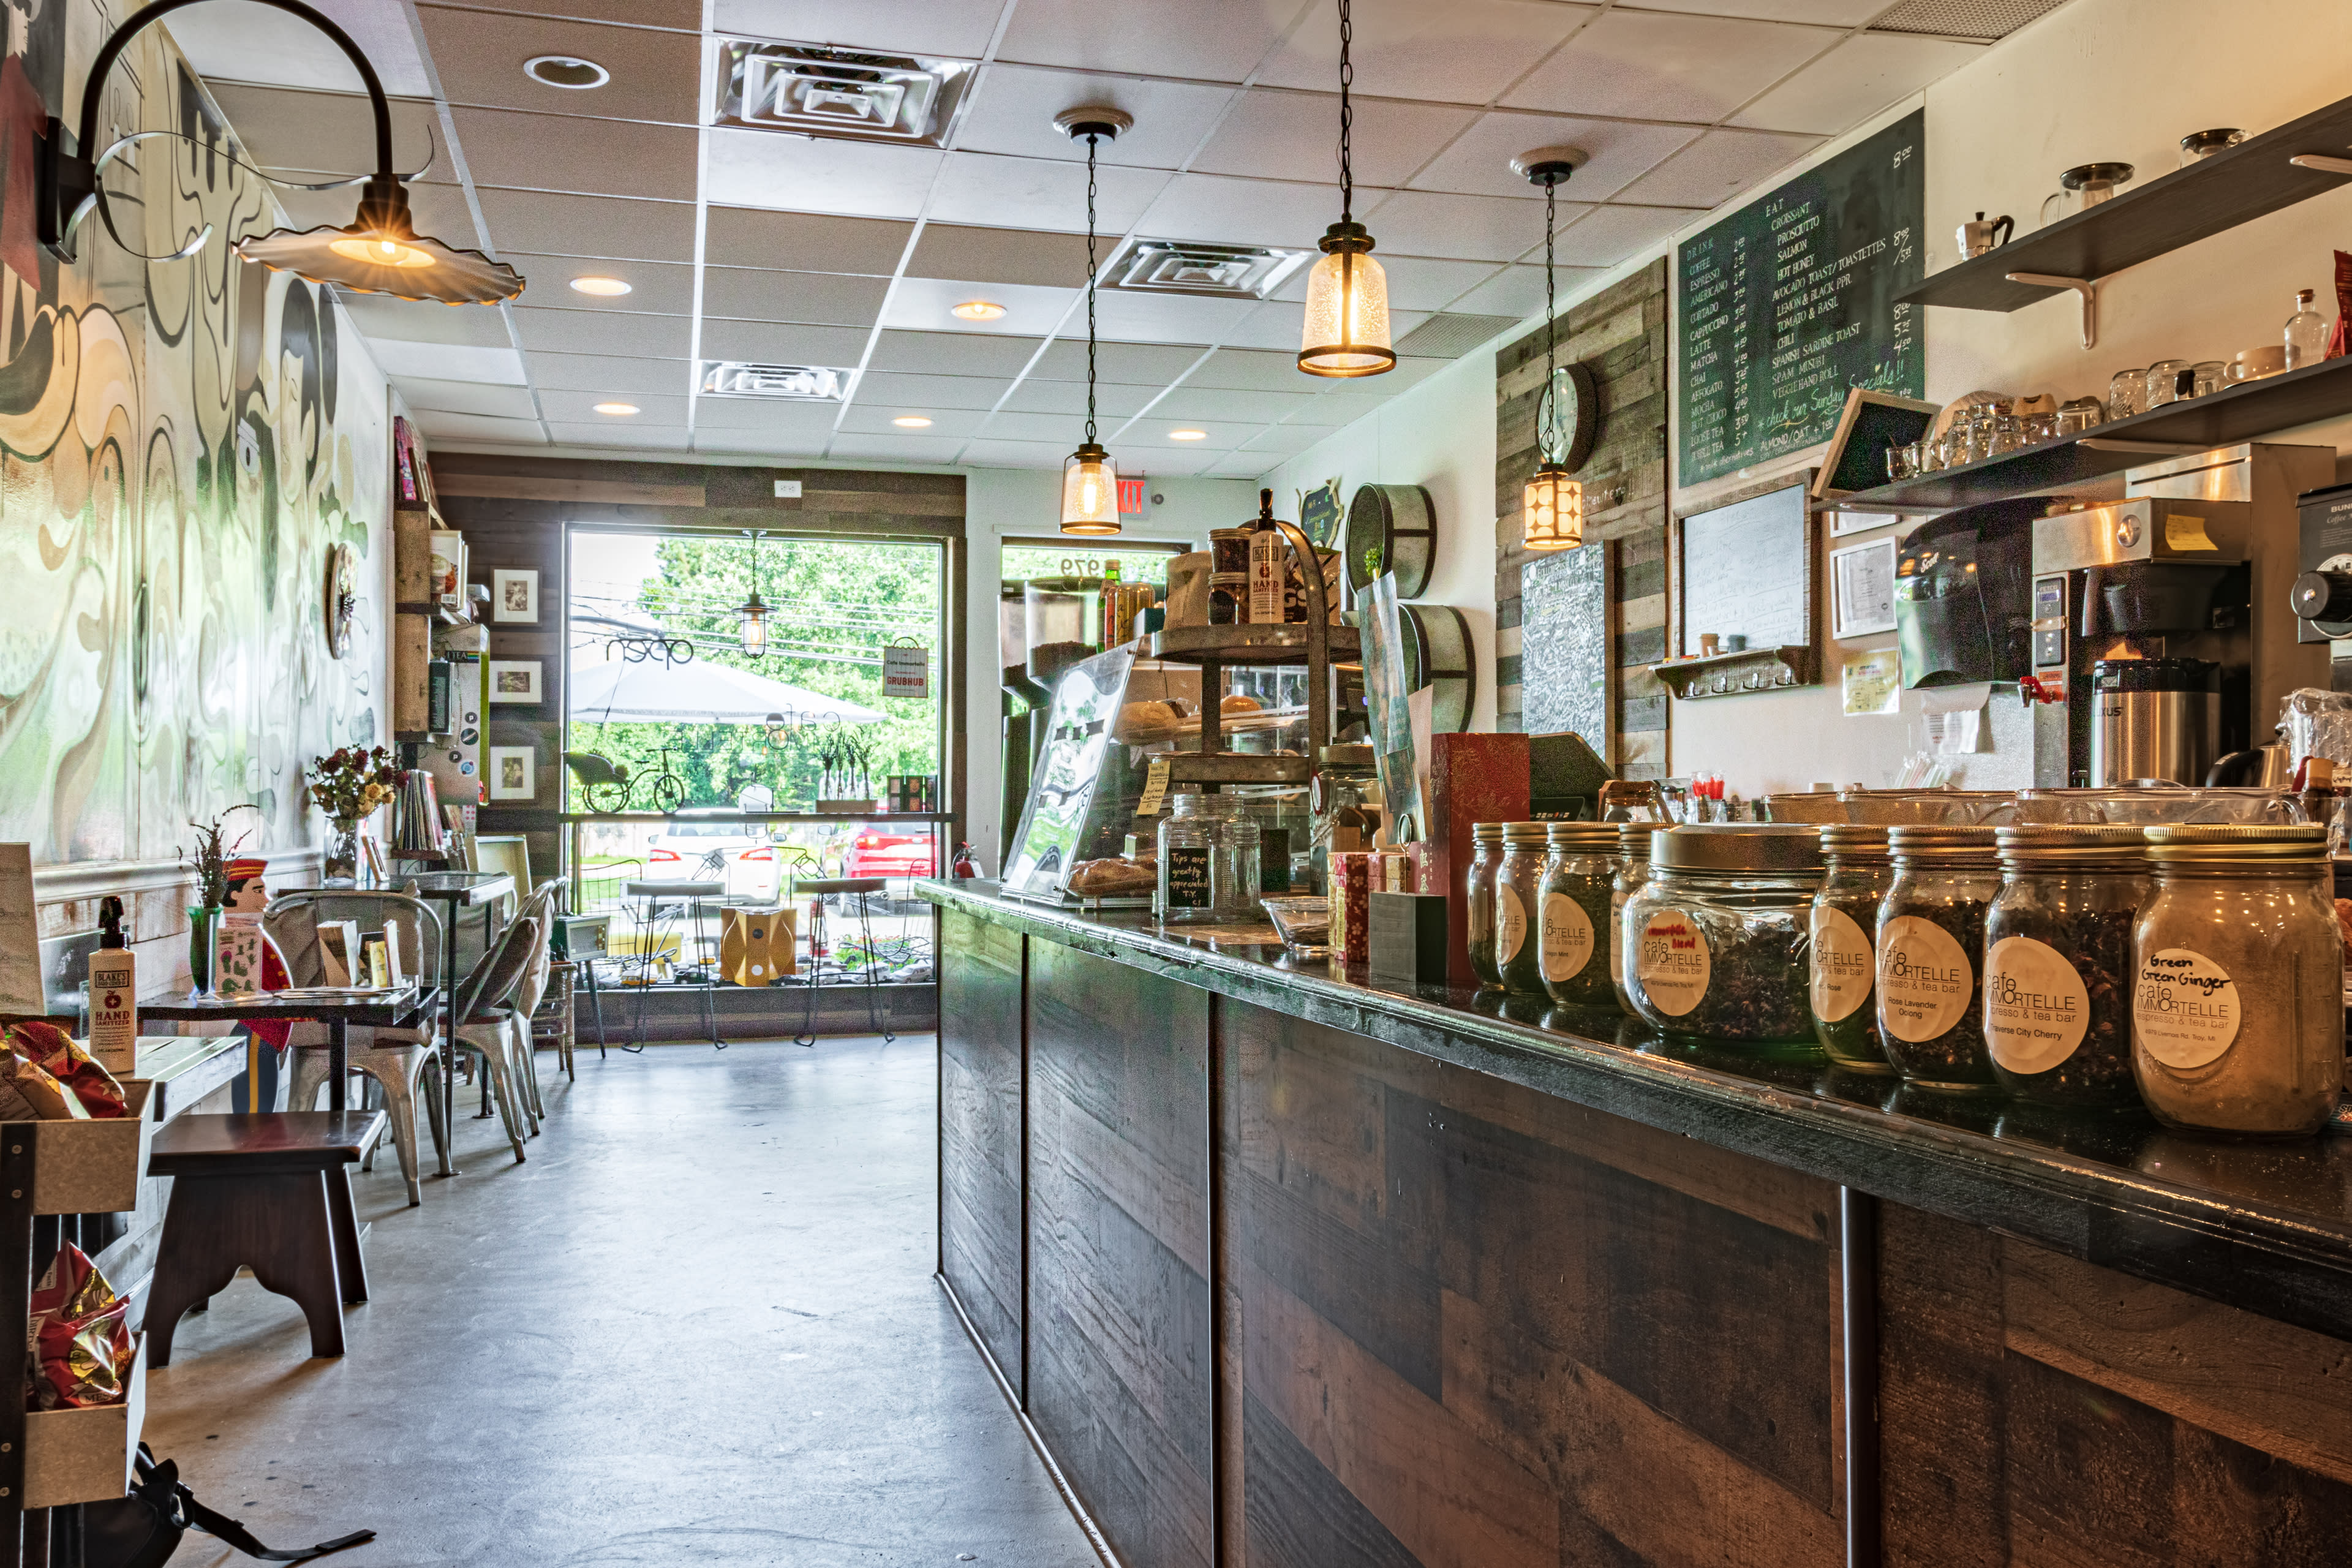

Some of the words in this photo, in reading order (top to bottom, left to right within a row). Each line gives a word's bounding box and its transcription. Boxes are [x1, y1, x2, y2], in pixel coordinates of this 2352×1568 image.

[1766, 198, 1784, 217] EAT
[1687, 237, 1714, 262] DRINK
[1777, 239, 1807, 263] SALMON
[1777, 265, 1792, 282] HOT
[1792, 253, 1815, 275] HONEY
[1691, 268, 1720, 292] ESPRESSO
[1691, 280, 1728, 307] AMERICANO
[1771, 277, 1806, 302] AVOCADO
[1777, 297, 1801, 317] LEMON
[1811, 281, 1835, 302] BLACK
[1691, 302, 1719, 324] CORTADO
[1777, 311, 1807, 333] TOMATO
[1818, 296, 1839, 314] BASIL
[1691, 338, 1711, 357] LATTE
[1803, 333, 1834, 356] SARDINE
[1836, 322, 1861, 342] TOAST
[1691, 351, 1718, 372] MATCHA
[1691, 372, 1706, 387] CHAI
[1772, 367, 1795, 385] SPAM
[1798, 373, 1818, 391] HAND
[1691, 380, 1723, 403] AFFOGATO
[1811, 385, 1845, 413] Sunday
[1691, 399, 1715, 418] MOCHA
[1711, 426, 1725, 439] TEA
[1711, 440, 1725, 453] TEA
[1920, 552, 1939, 573] Scott
[886, 676, 924, 687] GRUBHUB
[1171, 853, 1188, 865] Tips
[1172, 865, 1202, 878] greatly
[1644, 938, 1668, 953] cafe
[1879, 946, 1906, 963] cafe
[1644, 951, 1702, 966] IMMORTELLE
[2150, 954, 2193, 968] Green
[1691, 967, 1703, 975] bar
[1912, 980, 1918, 990] &
[1922, 982, 1937, 992] tea
[1942, 983, 1960, 993] bar
[1986, 971, 2016, 990] cafe
[2142, 968, 2176, 982] Green
[2178, 971, 2231, 997] Ginger
[2138, 982, 2172, 1000] cafe
[1888, 997, 1902, 1005] Rose
[1904, 999, 1937, 1009] Lavender
[2137, 998, 2229, 1018] IMMORTELLE
[95, 1011, 130, 1020] HAND
[2022, 1009, 2029, 1019] &
[2034, 1011, 2051, 1021] tea
[2056, 1012, 2077, 1023] bar
[2136, 1012, 2174, 1025] espresso
[2178, 1016, 2185, 1025] &
[2189, 1018, 2206, 1028] tea
[2210, 1019, 2230, 1030] bar
[1991, 1023, 2015, 1035] Traverse
[2016, 1027, 2032, 1038] City
[2034, 1029, 2062, 1041] Cherry
